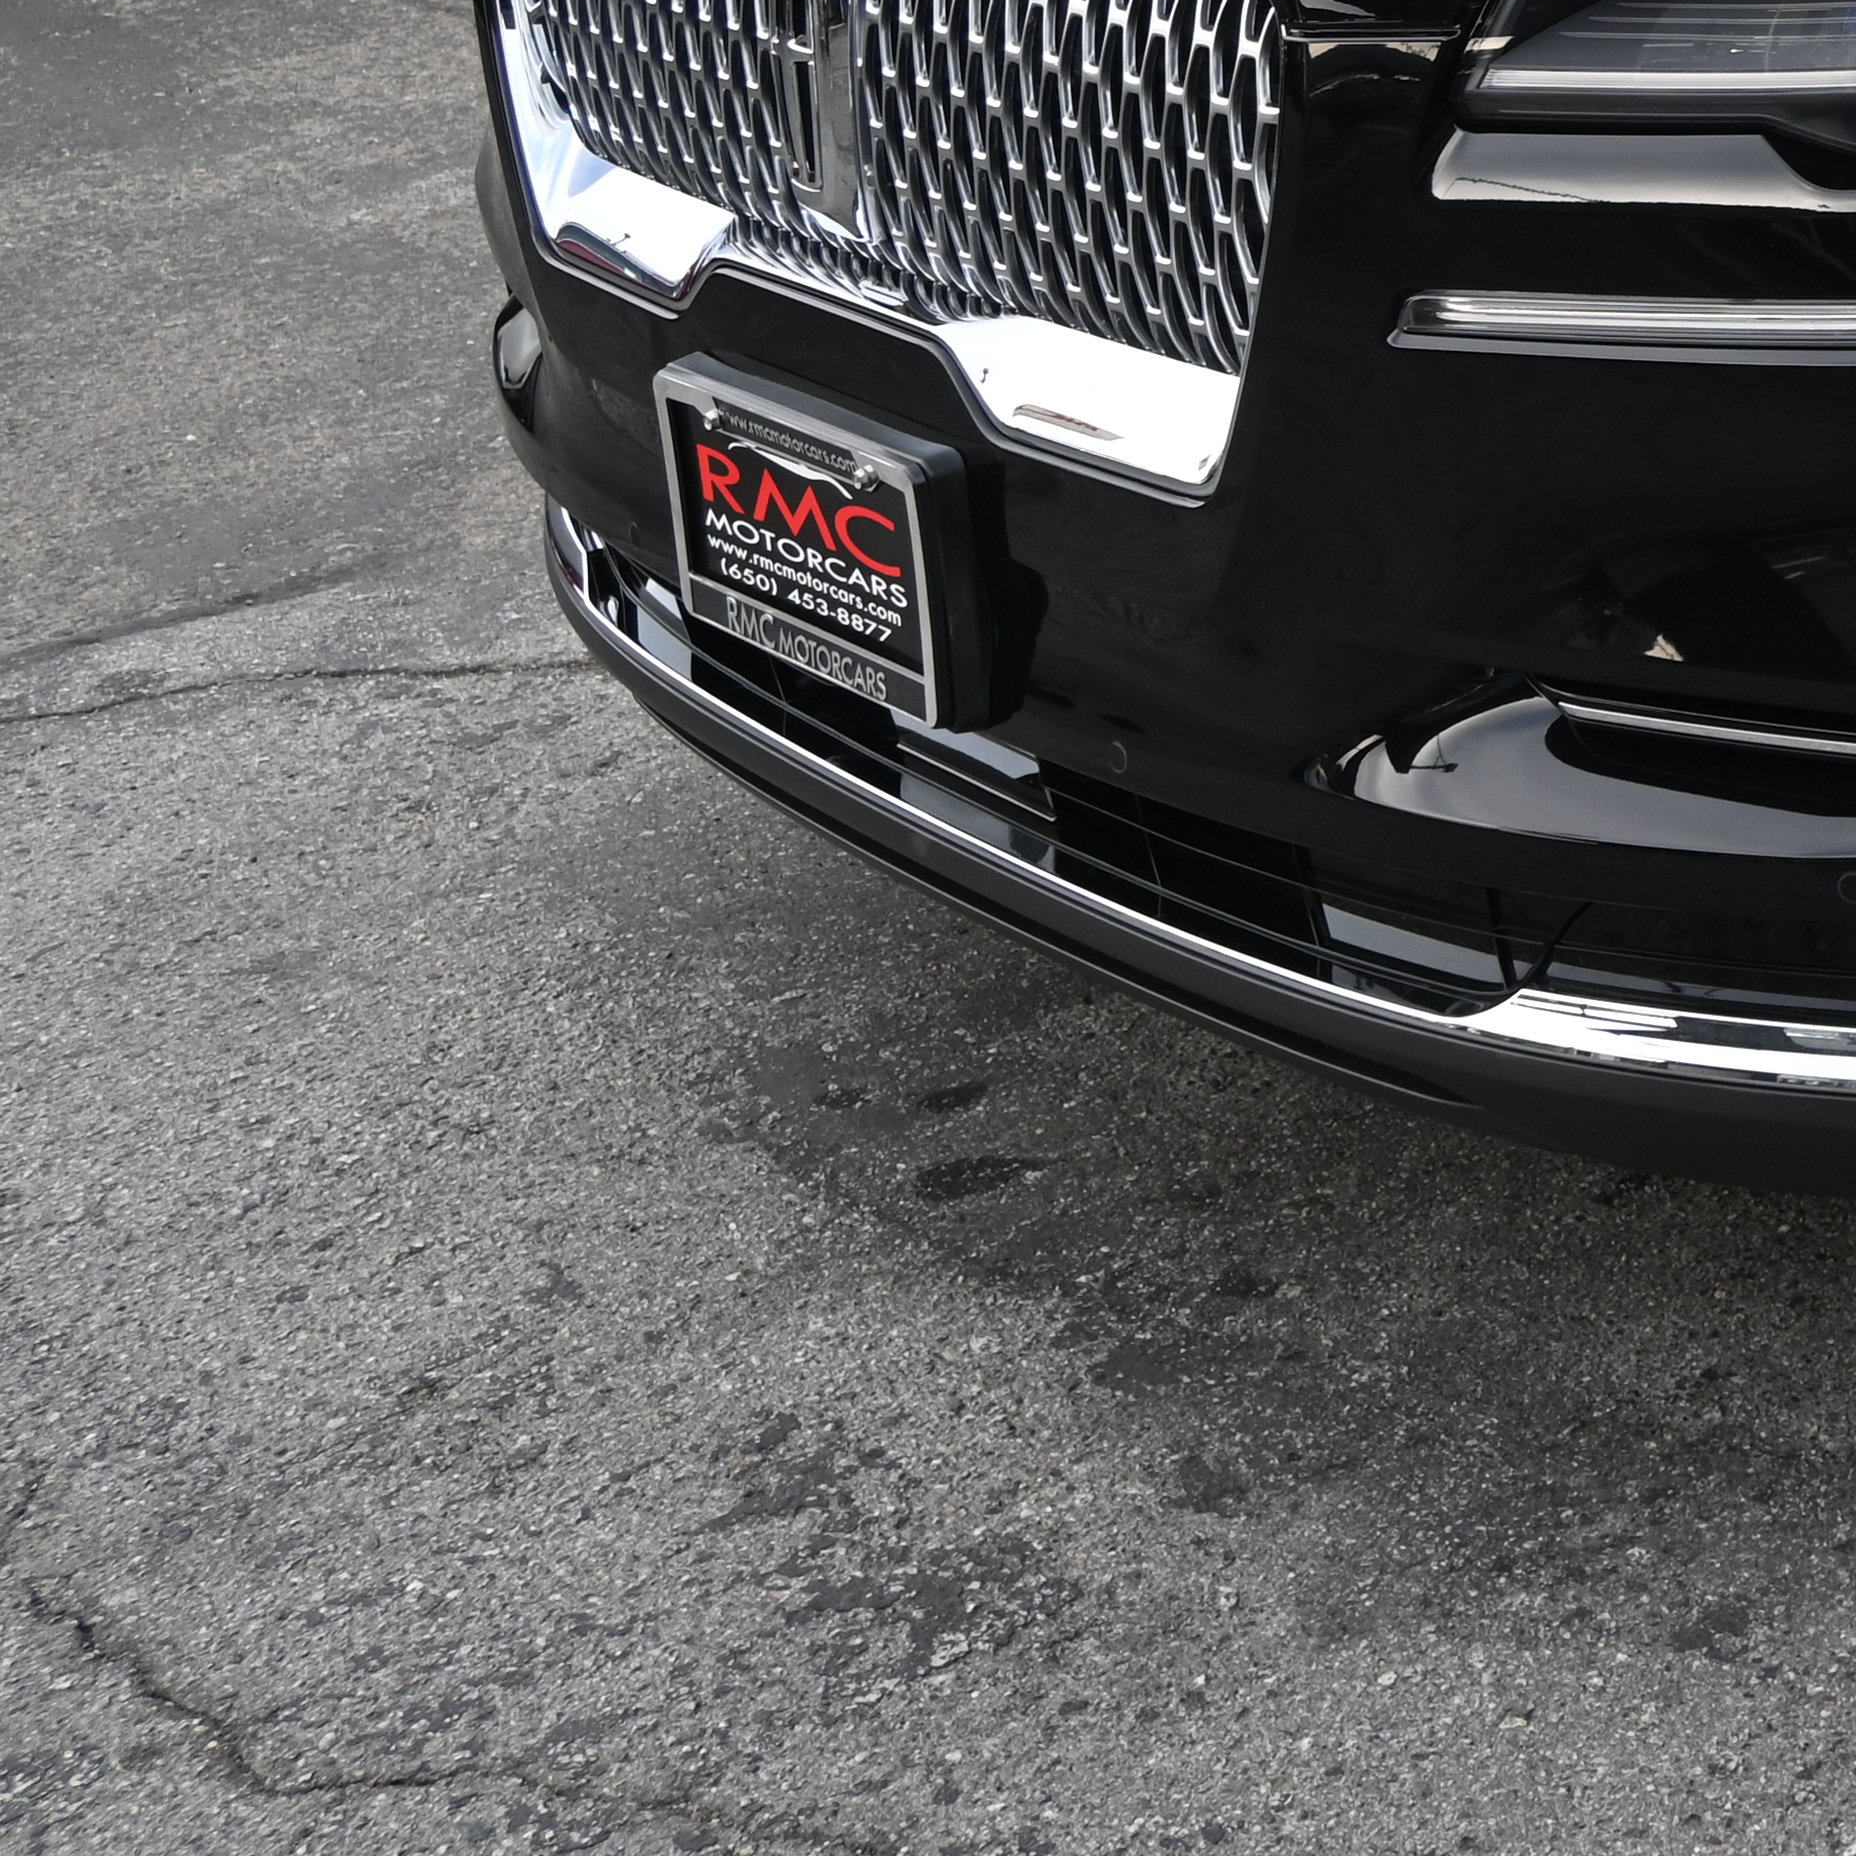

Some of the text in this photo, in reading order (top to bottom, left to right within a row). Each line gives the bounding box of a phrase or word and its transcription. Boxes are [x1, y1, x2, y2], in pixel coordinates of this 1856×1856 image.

[696, 444, 901, 577] RMC
[705, 508, 908, 608] MOTORCARS
[707, 534, 902, 627] www.rmcmotorcars.com
[721, 557, 892, 642] (650) 453-8877
[727, 597, 887, 701] RMC MOTORCARS
